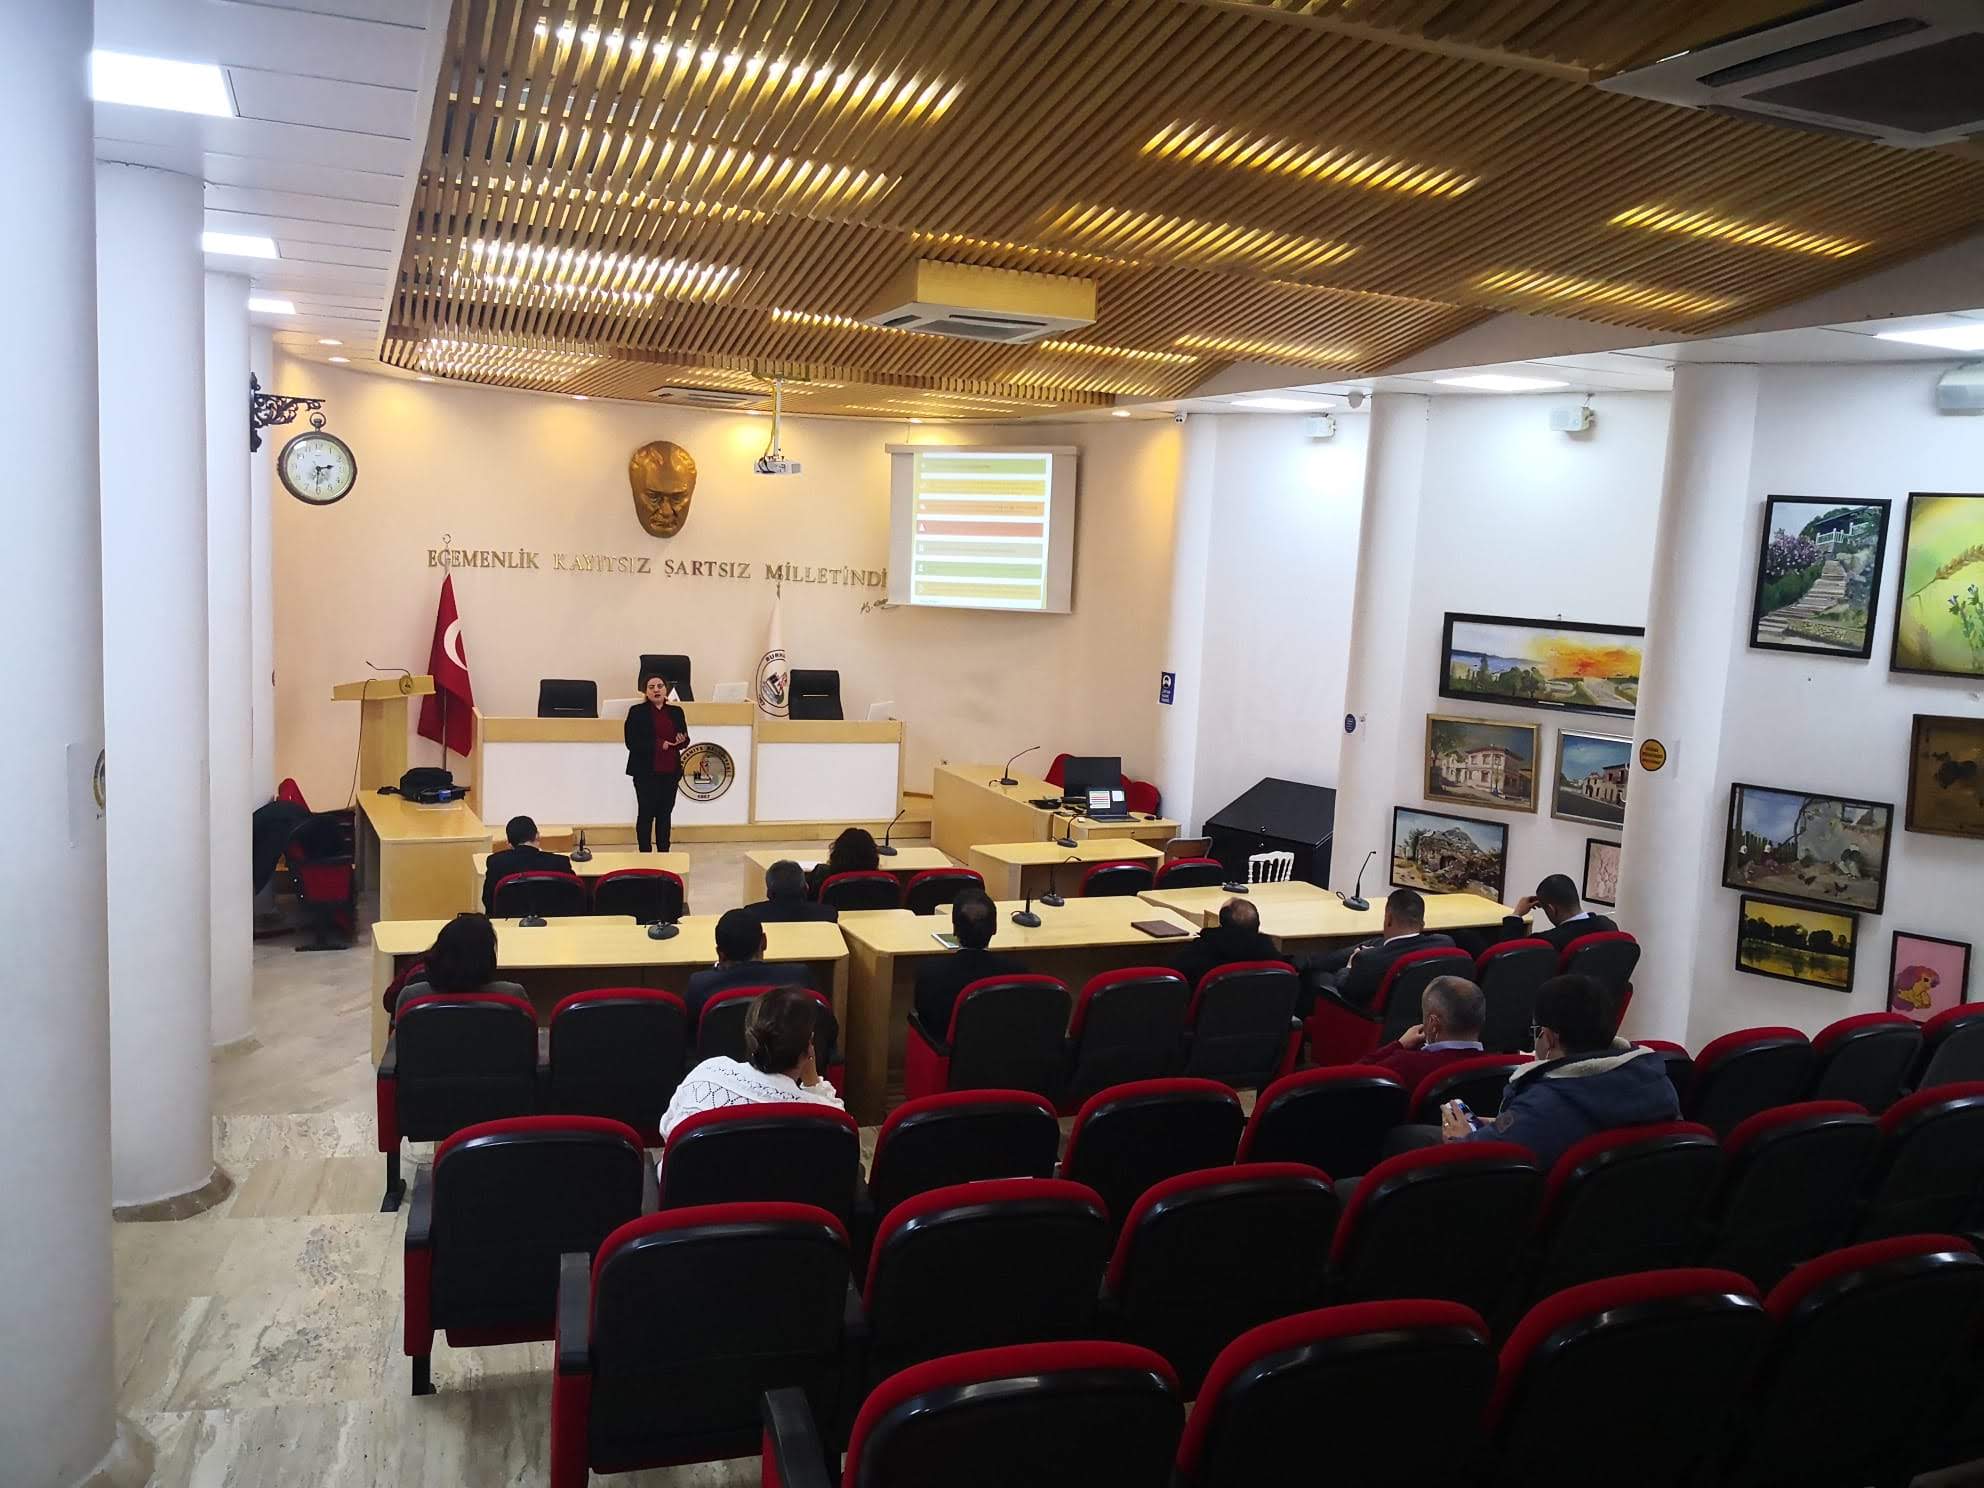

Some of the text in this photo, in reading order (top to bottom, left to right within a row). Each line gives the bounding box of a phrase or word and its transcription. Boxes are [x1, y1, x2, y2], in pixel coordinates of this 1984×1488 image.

[428, 548, 888, 588] EGEMENLİK KAYITSIZ ŞARTSIZ MİLLETİNDİ
